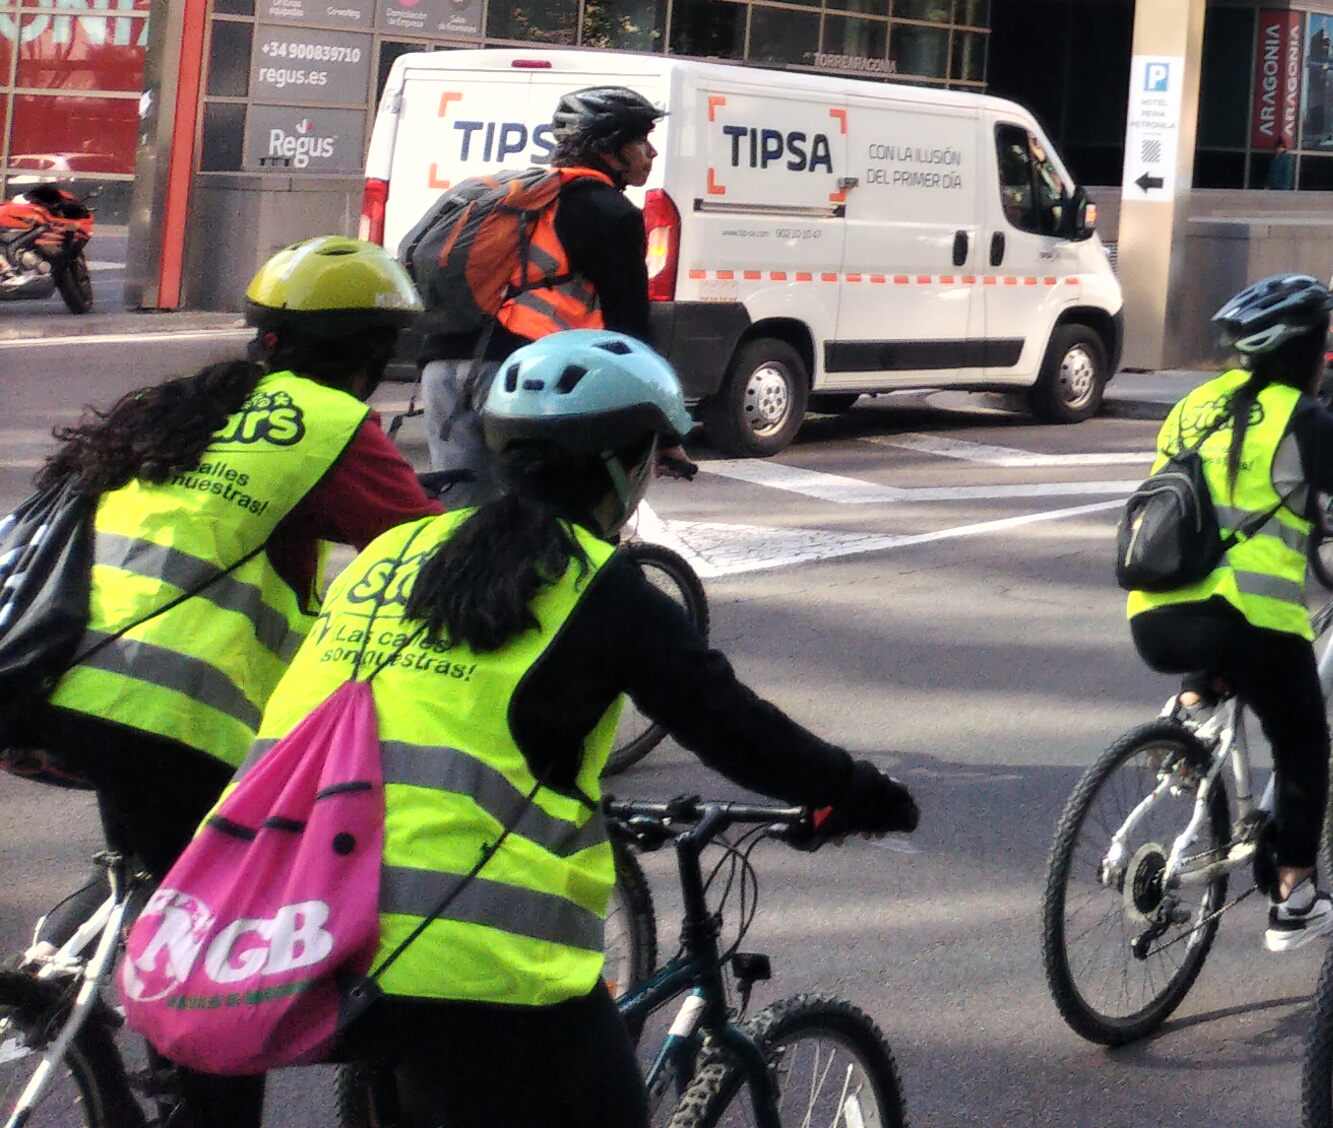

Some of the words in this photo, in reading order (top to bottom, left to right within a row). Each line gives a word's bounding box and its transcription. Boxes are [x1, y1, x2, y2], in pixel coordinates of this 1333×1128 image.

[261, 41, 287, 58] +34
[259, 67, 327, 88] regus.es
[1259, 24, 1281, 137] ARAGONIA
[268, 128, 334, 168] Regus
[453, 120, 555, 165] TIPS
[723, 125, 833, 174] TIPSA
[869, 143, 895, 161] CON
[897, 146, 913, 162] LA
[866, 168, 890, 185] DEL
[893, 171, 940, 188] PRIMER
[942, 170, 962, 190] DÍA
[198, 460, 250, 487] alles
